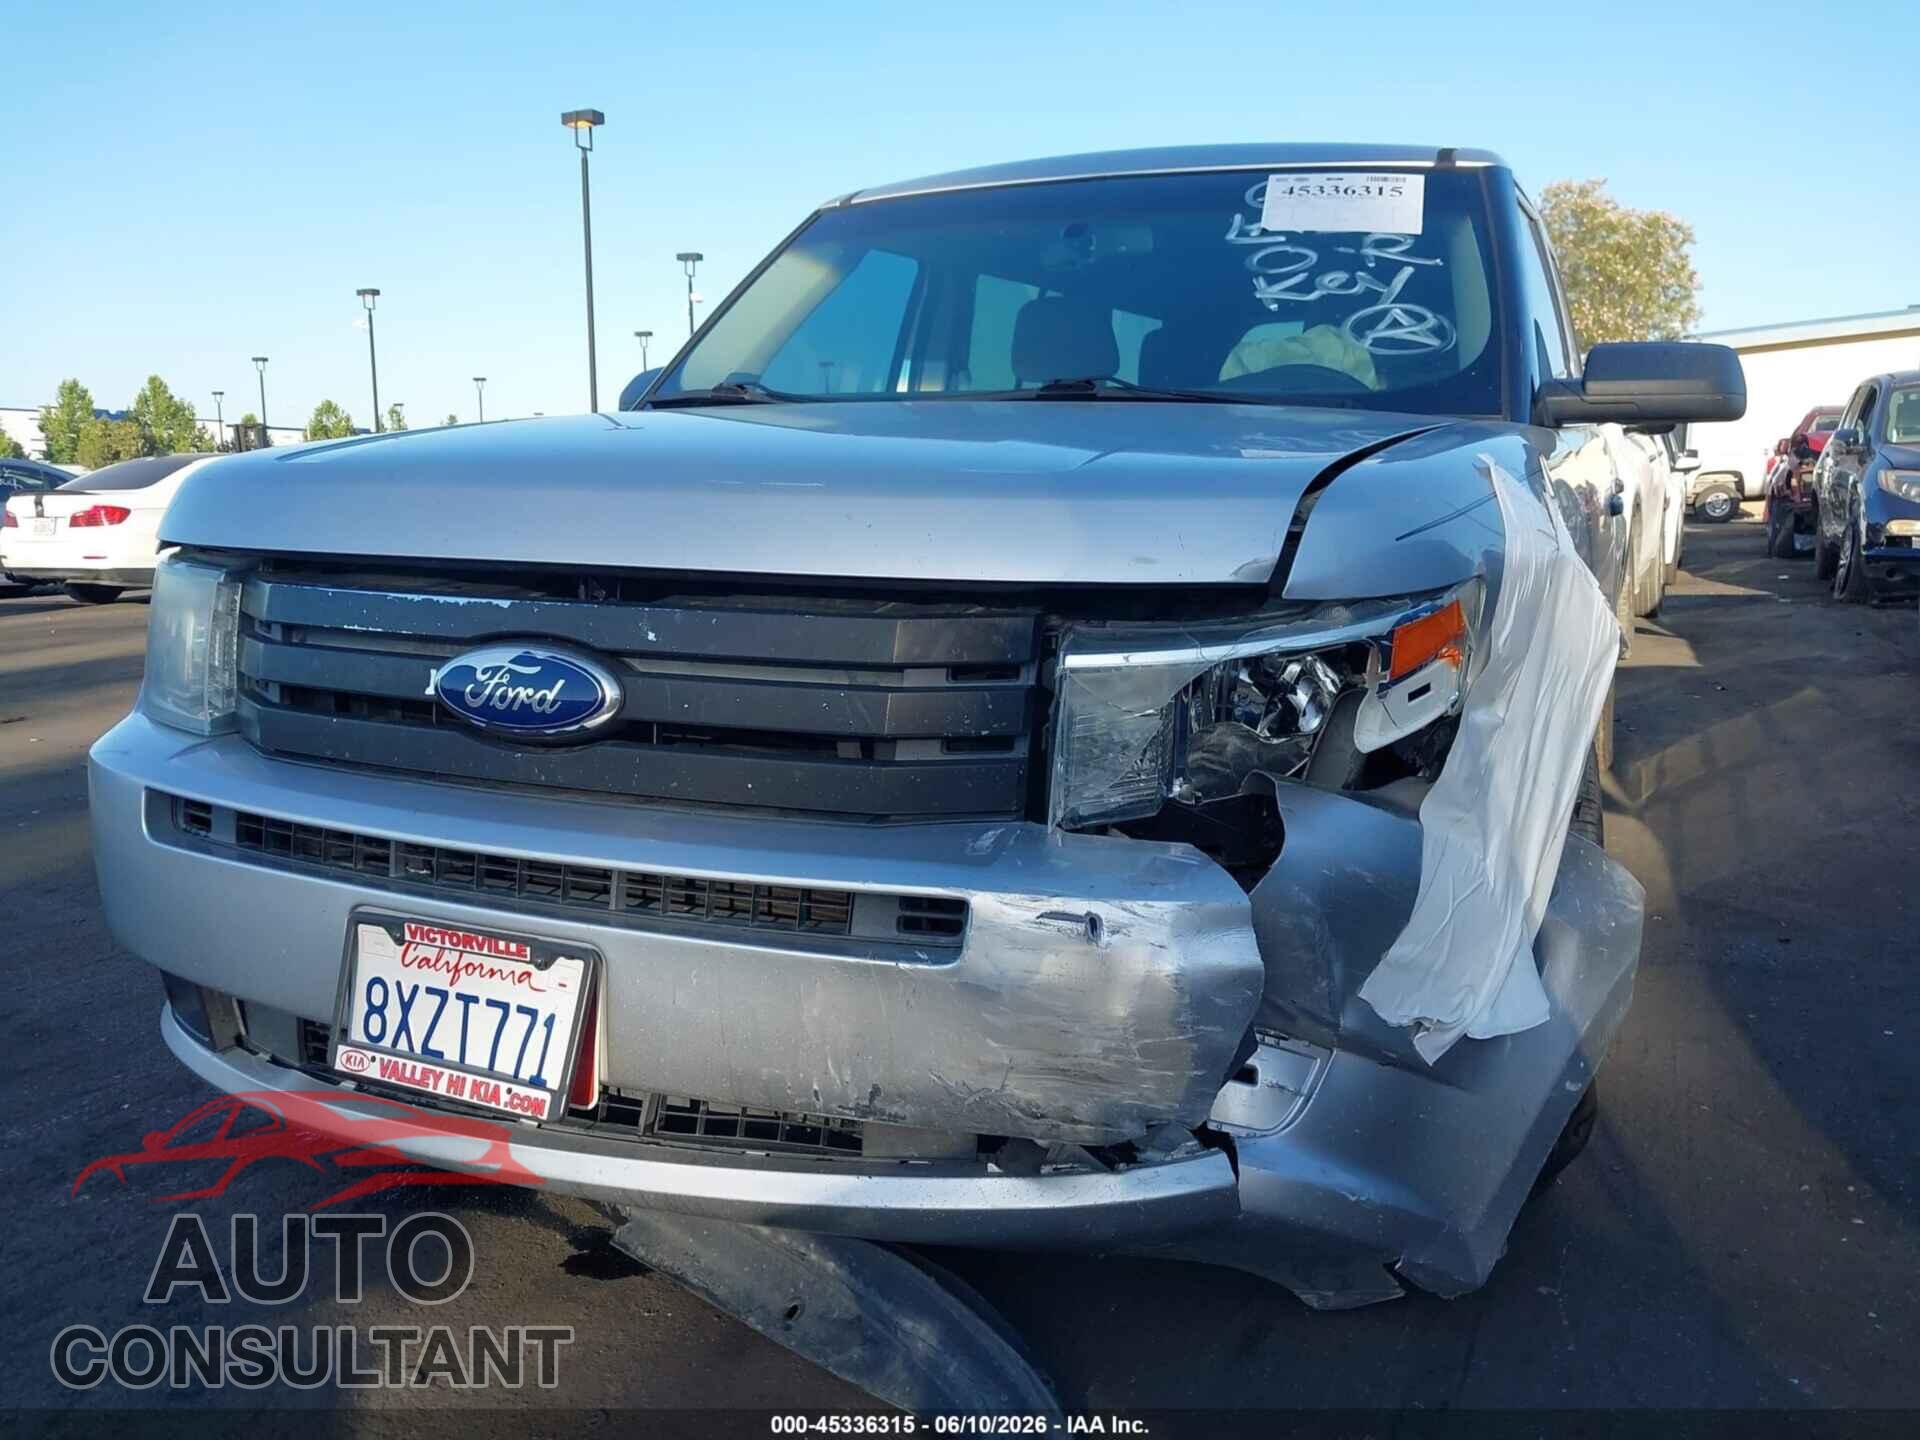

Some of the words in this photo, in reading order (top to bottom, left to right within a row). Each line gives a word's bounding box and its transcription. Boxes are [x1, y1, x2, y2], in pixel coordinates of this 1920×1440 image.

[1282, 184, 1404, 198] 45336315
[464, 663, 566, 714] Ford
[405, 923, 528, 959] VICTORVILLE
[400, 942, 546, 992] California
[363, 976, 556, 1089] 8XZT771
[345, 1054, 365, 1069] KIA
[379, 1057, 445, 1091] VALLEY
[446, 1073, 465, 1096] HI
[469, 1080, 501, 1105] KIA
[504, 1092, 547, 1117] .COM
